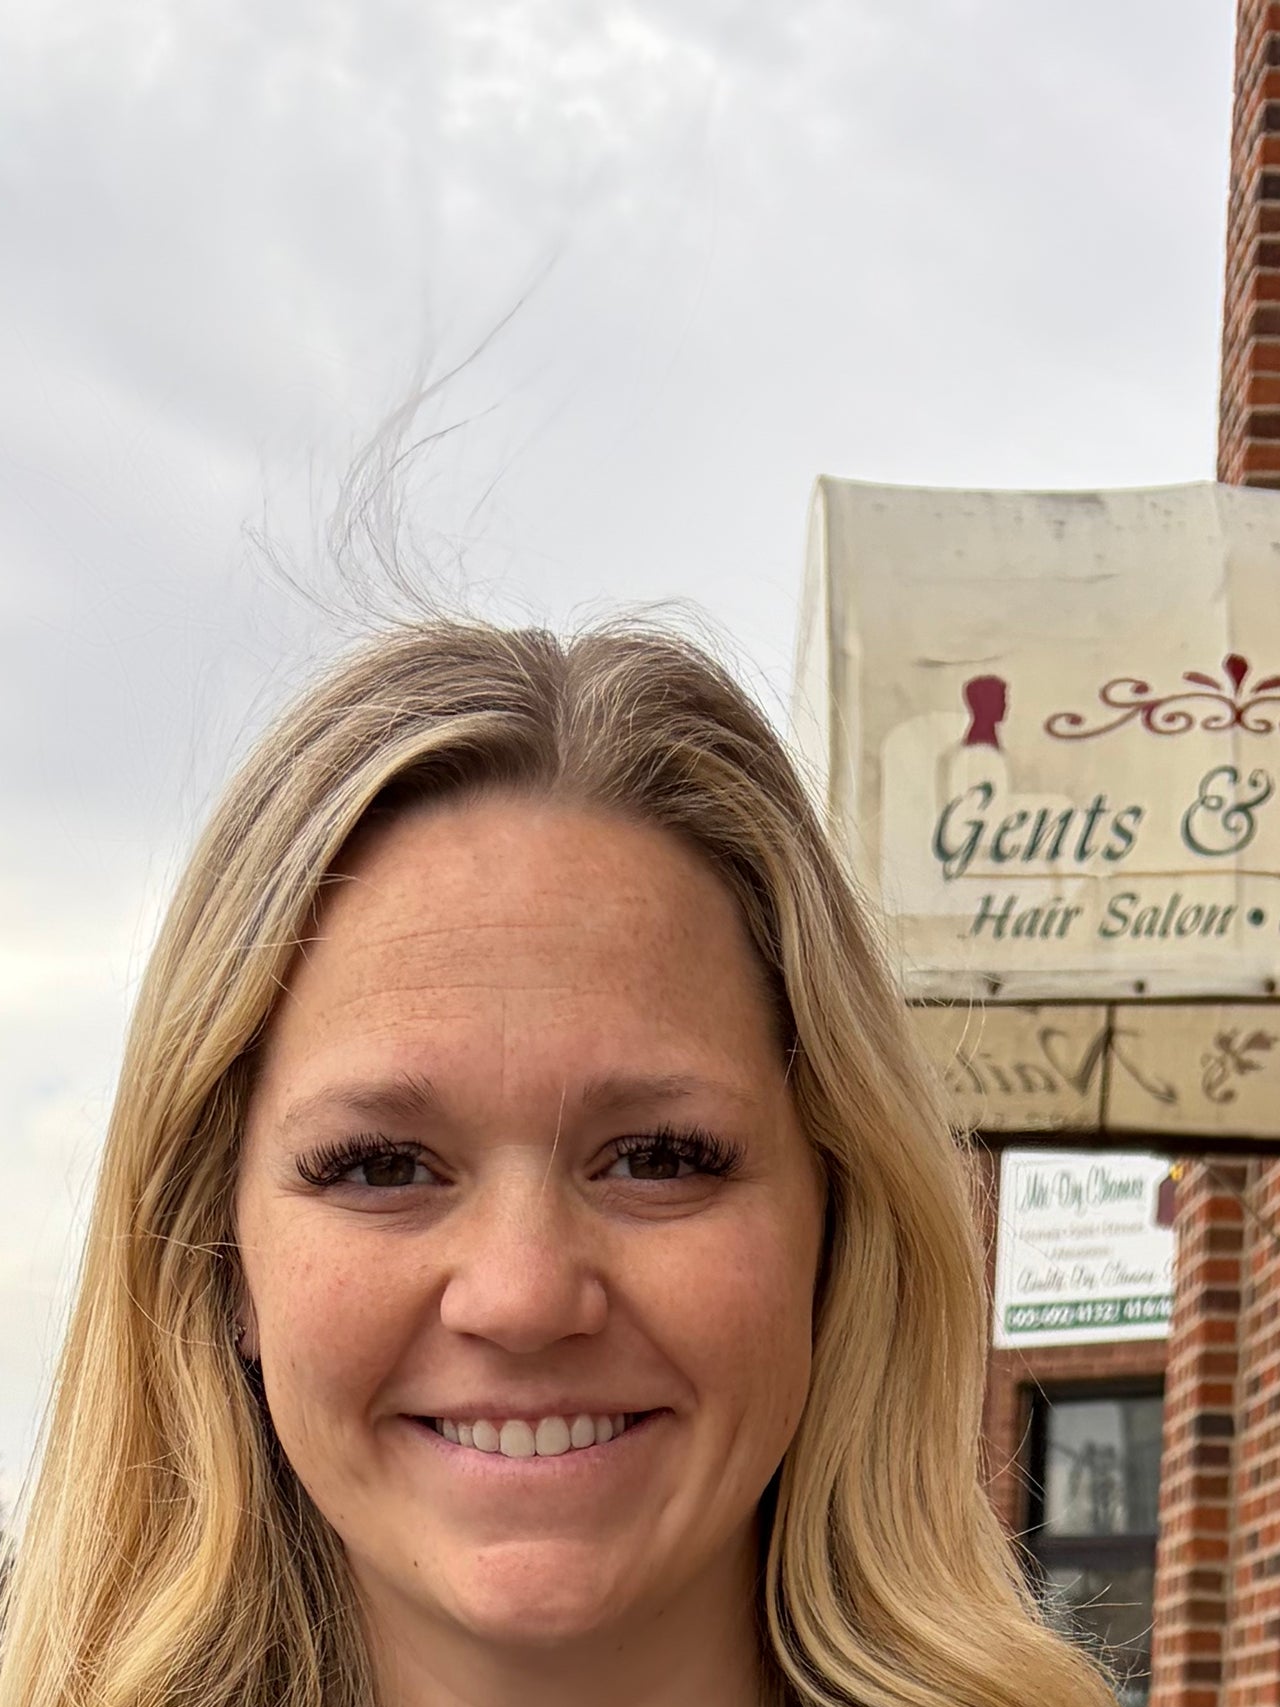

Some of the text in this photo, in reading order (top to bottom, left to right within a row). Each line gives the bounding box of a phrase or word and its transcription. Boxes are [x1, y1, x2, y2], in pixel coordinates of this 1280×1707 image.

[932, 782, 1144, 881] Gents
[1181, 765, 1276, 858] &
[968, 892, 1084, 940] Hair
[1097, 891, 1237, 940] Salon
